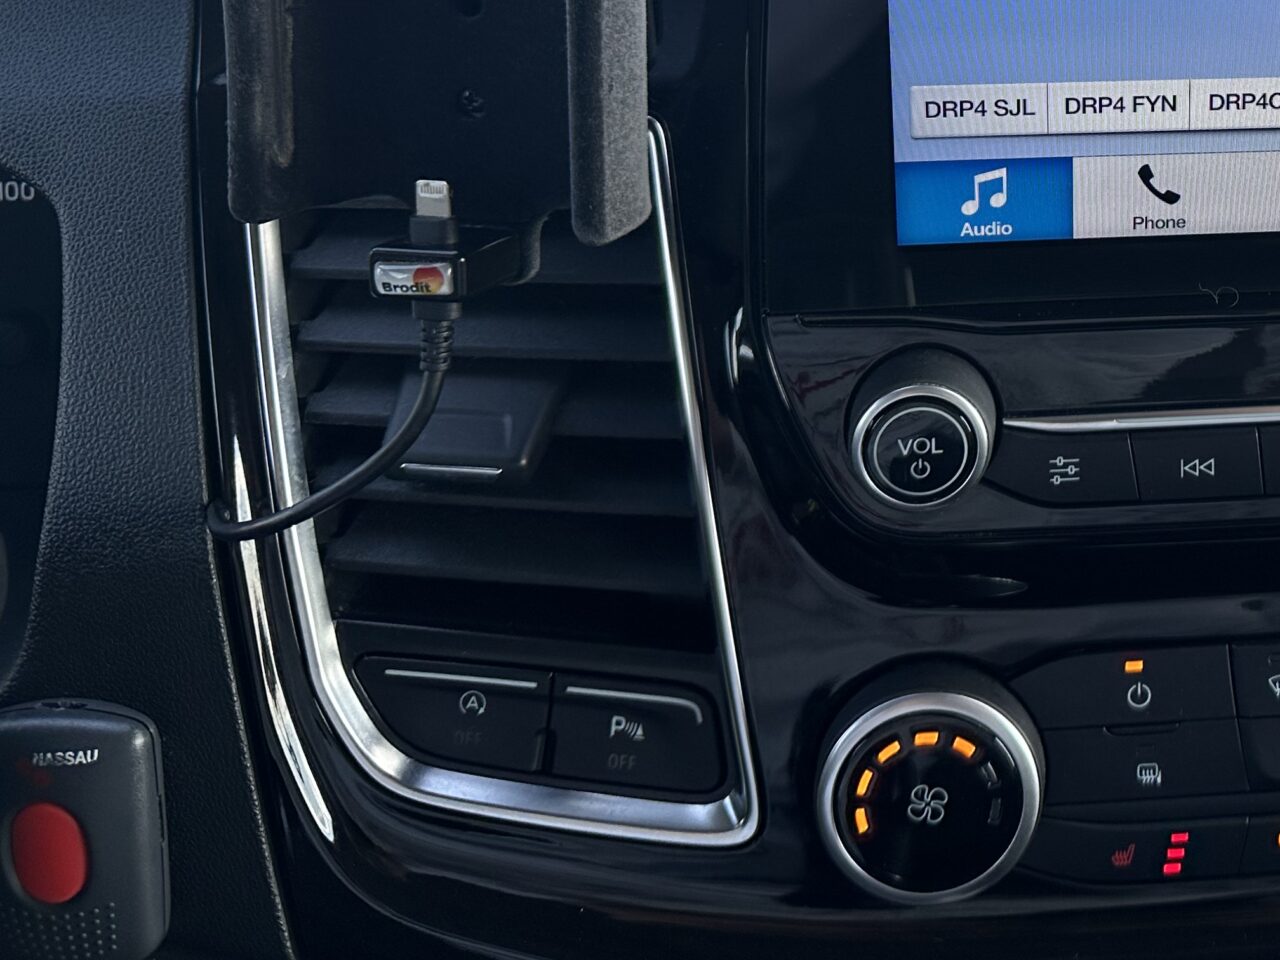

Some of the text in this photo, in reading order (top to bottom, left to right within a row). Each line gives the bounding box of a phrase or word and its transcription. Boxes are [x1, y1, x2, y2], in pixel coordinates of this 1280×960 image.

[924, 97, 1036, 119] DRP4 SJL
[1064, 94, 1178, 115] DRP4 FYN
[960, 221, 1013, 238] Audio
[1132, 214, 1186, 230] Phone
[381, 281, 432, 293] Brodit
[898, 437, 943, 457] VOL
[608, 753, 638, 770] OFF
